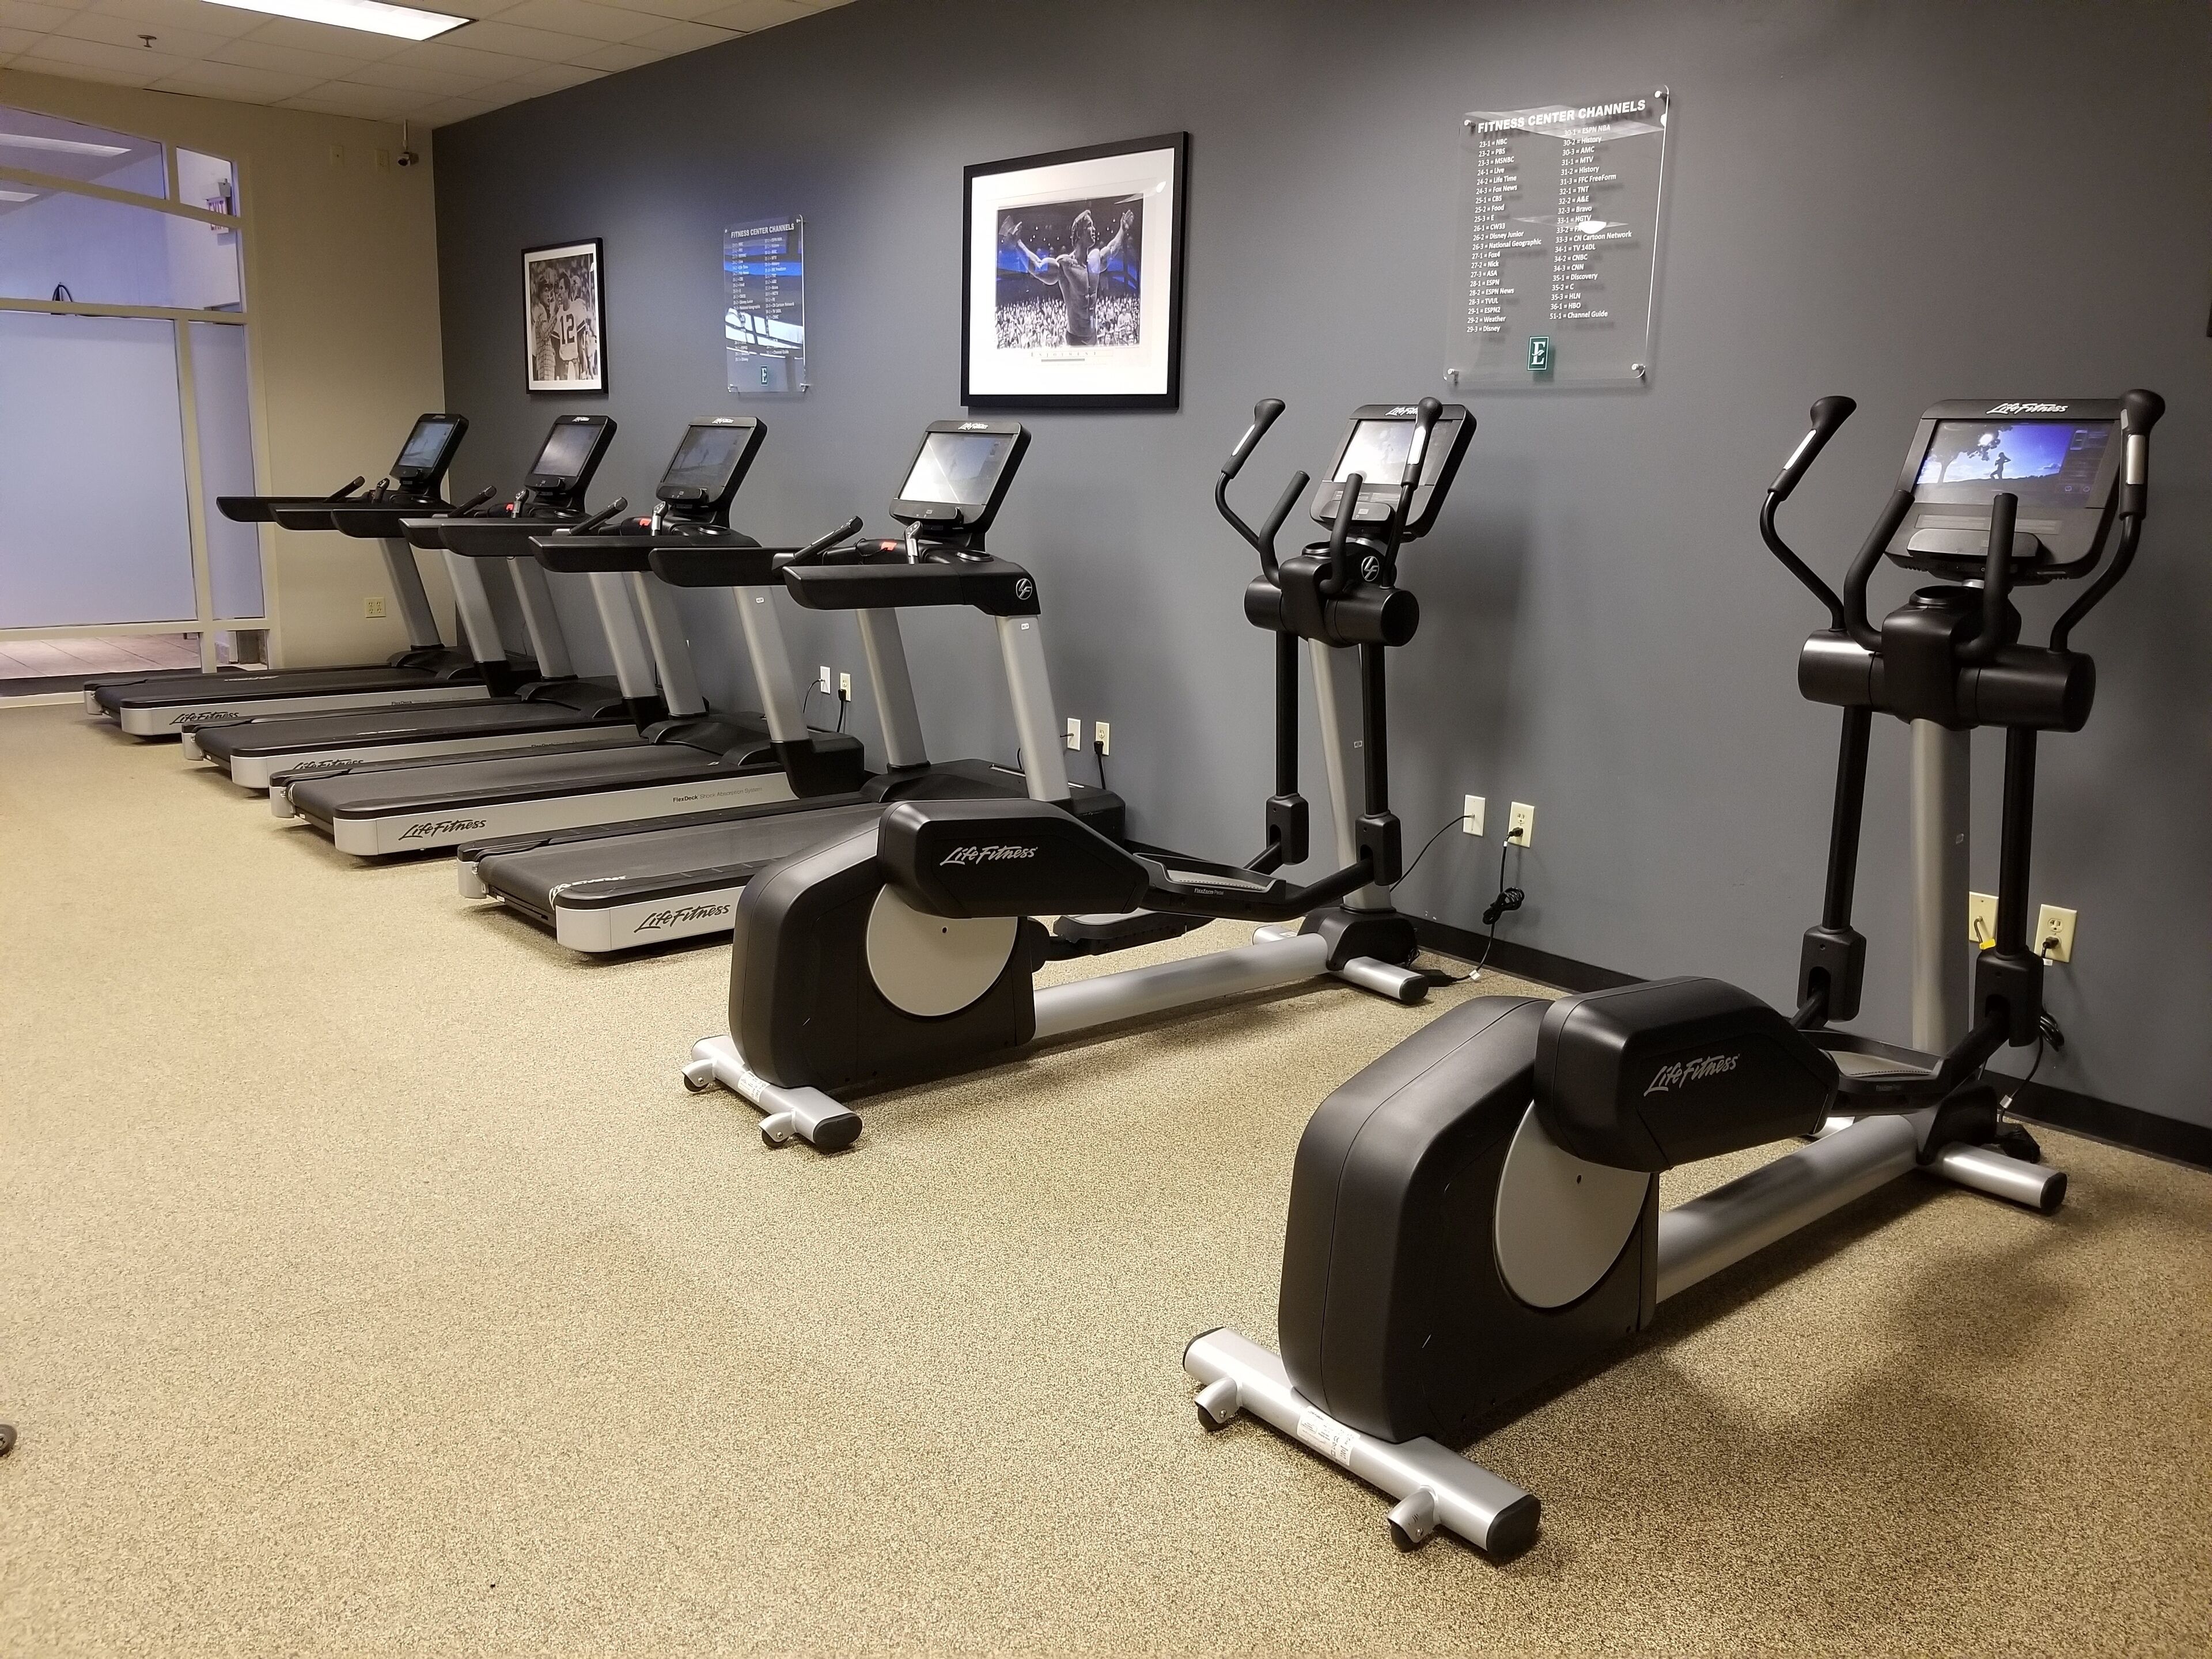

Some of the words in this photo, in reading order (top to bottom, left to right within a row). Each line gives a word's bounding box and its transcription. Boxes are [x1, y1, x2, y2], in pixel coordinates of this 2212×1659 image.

[1478, 118, 1525, 133] FITNESS
[1528, 110, 1575, 126] CENTER
[1578, 100, 1646, 119] CHANNELS
[1580, 146, 1594, 154] AMC
[1495, 156, 1514, 164] MSNBC
[1580, 156, 1594, 164] MTV
[1589, 174, 1616, 182] FreeForm
[731, 229, 749, 238] FITNESS
[750, 227, 768, 236] CENTER
[769, 223, 794, 233] CHANNELS
[1607, 230, 1632, 239] Network
[1488, 241, 1511, 249] National
[1512, 238, 1541, 247] Geographic
[560, 313, 575, 345] 12
[673, 794, 699, 802] FlexDeck
